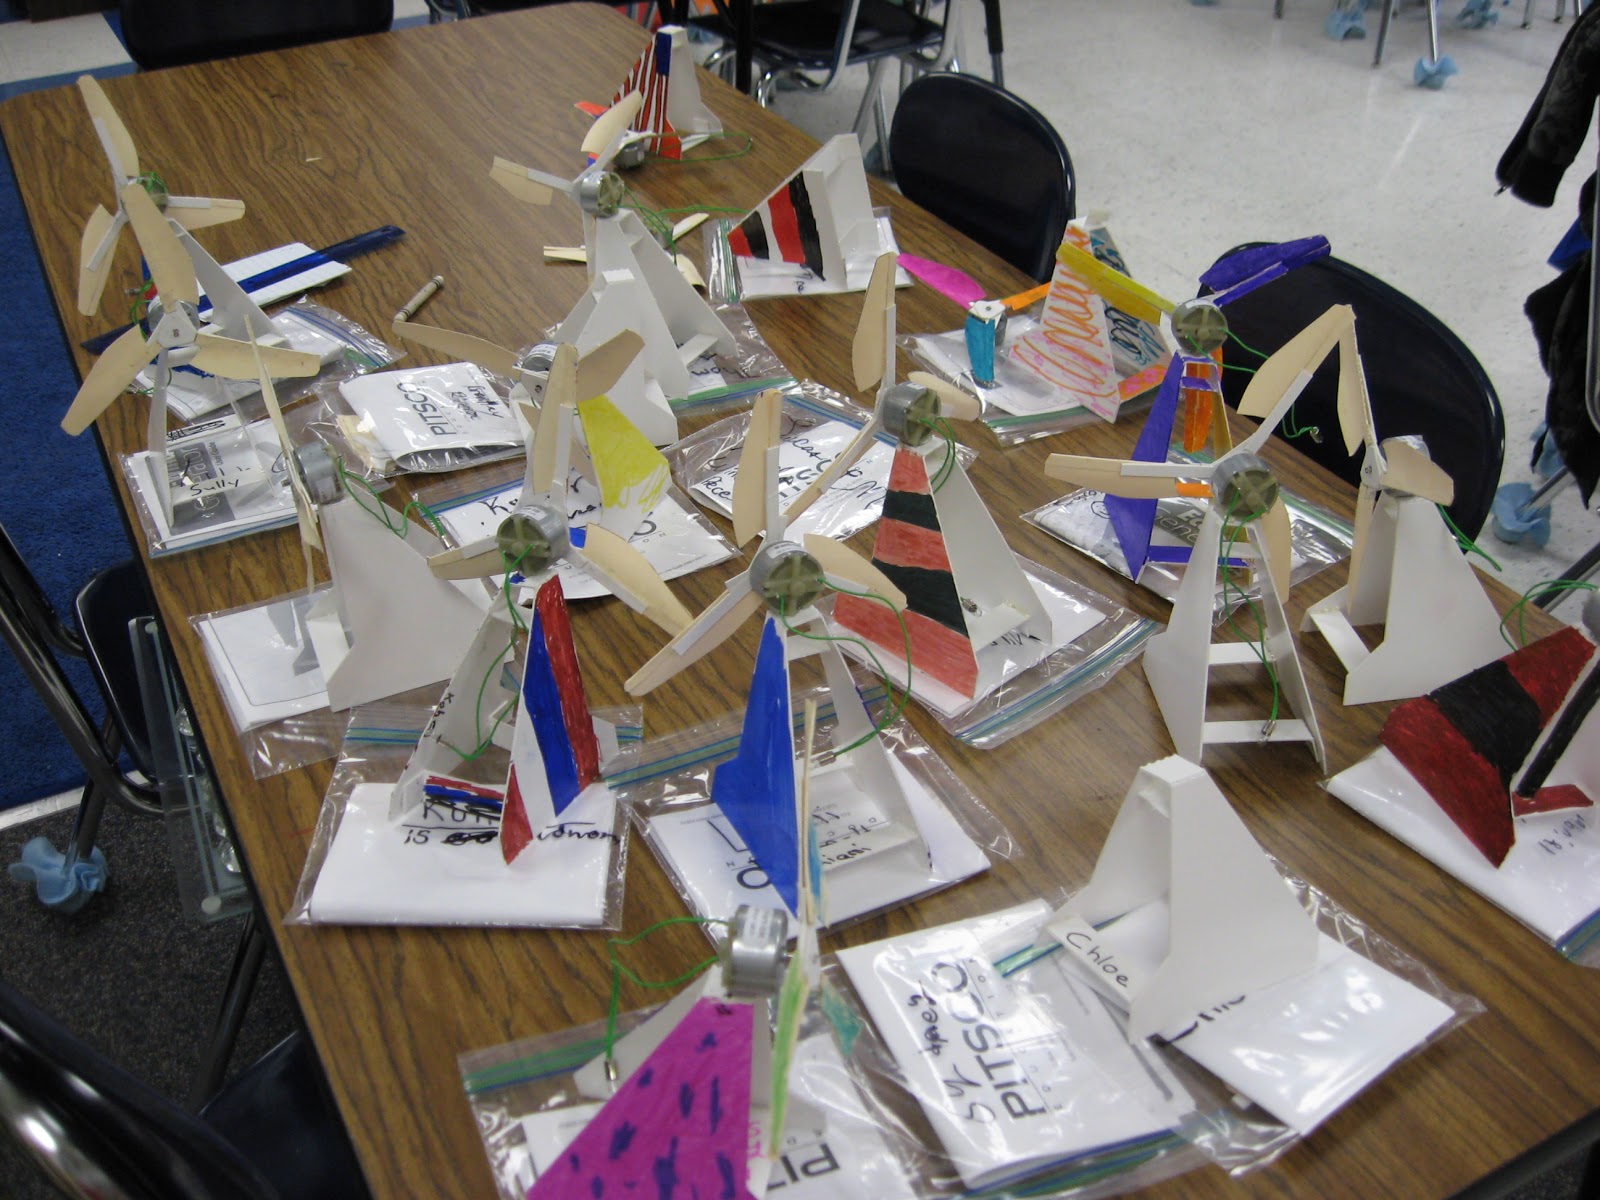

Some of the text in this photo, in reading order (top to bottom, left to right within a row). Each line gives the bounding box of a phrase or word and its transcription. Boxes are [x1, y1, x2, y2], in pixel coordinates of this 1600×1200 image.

[189, 478, 240, 497] Sully
[1066, 932, 1129, 988] Chloe
[931, 962, 1048, 1119] PITSCO
